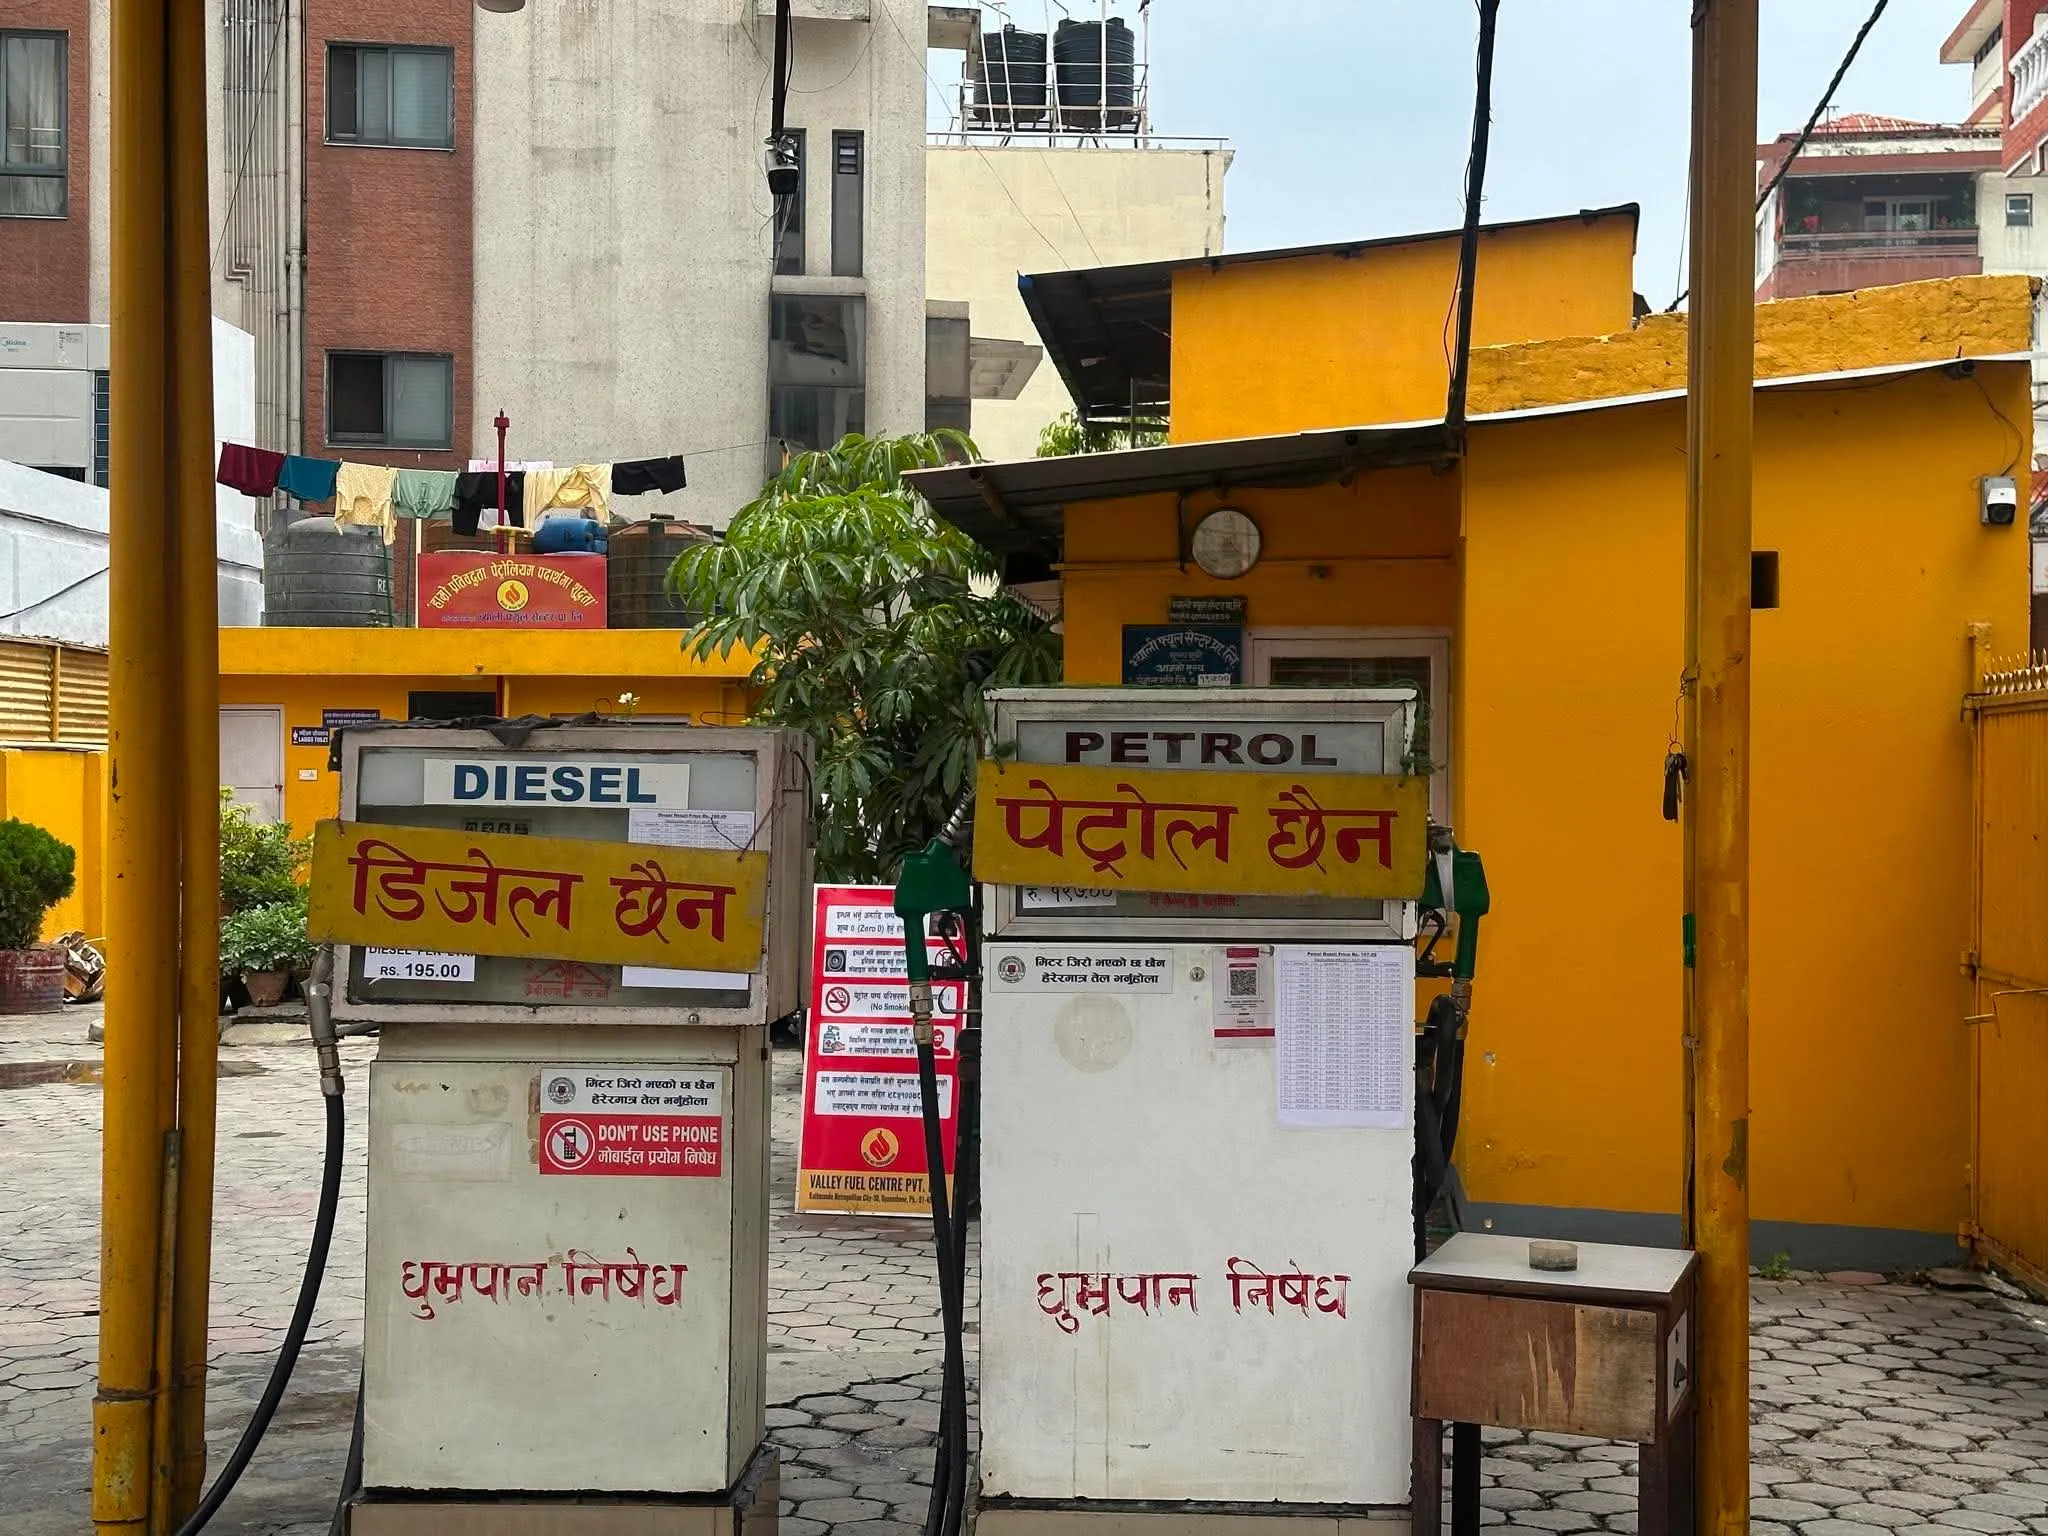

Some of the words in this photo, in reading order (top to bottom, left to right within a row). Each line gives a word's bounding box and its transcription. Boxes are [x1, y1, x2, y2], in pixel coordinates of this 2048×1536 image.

[490, 560, 534, 580] पेट्रोलियम
[537, 566, 574, 590] पदार्थमा
[1064, 731, 1338, 766] PETROL
[453, 764, 657, 804] DIESEL
[995, 778, 1239, 879] पेट्रोल
[1267, 783, 1399, 875] छैन
[347, 838, 585, 938] डिजेल
[609, 859, 737, 945] छैन
[380, 966, 399, 976] RS.
[405, 963, 460, 978] 195.00
[1035, 956, 1063, 967] मिटर
[1066, 956, 1092, 967] जिरो
[1095, 956, 1126, 967] भएको
[1130, 959, 1143, 967] छ
[1145, 957, 1166, 968] छैन
[1091, 972, 1110, 983] तेल
[870, 1003, 882, 1012] (No
[884, 1003, 910, 1011] Smokin
[585, 1077, 614, 1089] मिटर
[617, 1077, 642, 1089] जिरो
[645, 1078, 676, 1090] भएको
[679, 1081, 692, 1090] छ
[694, 1079, 716, 1090] छैन
[641, 1094, 660, 1105] तेल
[598, 1124, 639, 1142] DON'T
[643, 1125, 669, 1142] USE
[672, 1125, 718, 1143] PHONE
[598, 1146, 644, 1165] मोबाईल
[648, 1147, 682, 1166] प्रयोग
[684, 1147, 717, 1165] निषेध
[810, 1174, 842, 1190] VALLEY
[844, 1175, 865, 1191] FUEL
[868, 1176, 903, 1192] CENTRE
[905, 1178, 925, 1193] PVT.
[561, 1246, 689, 1309] निषेध
[1226, 1256, 1351, 1320] निषेध
